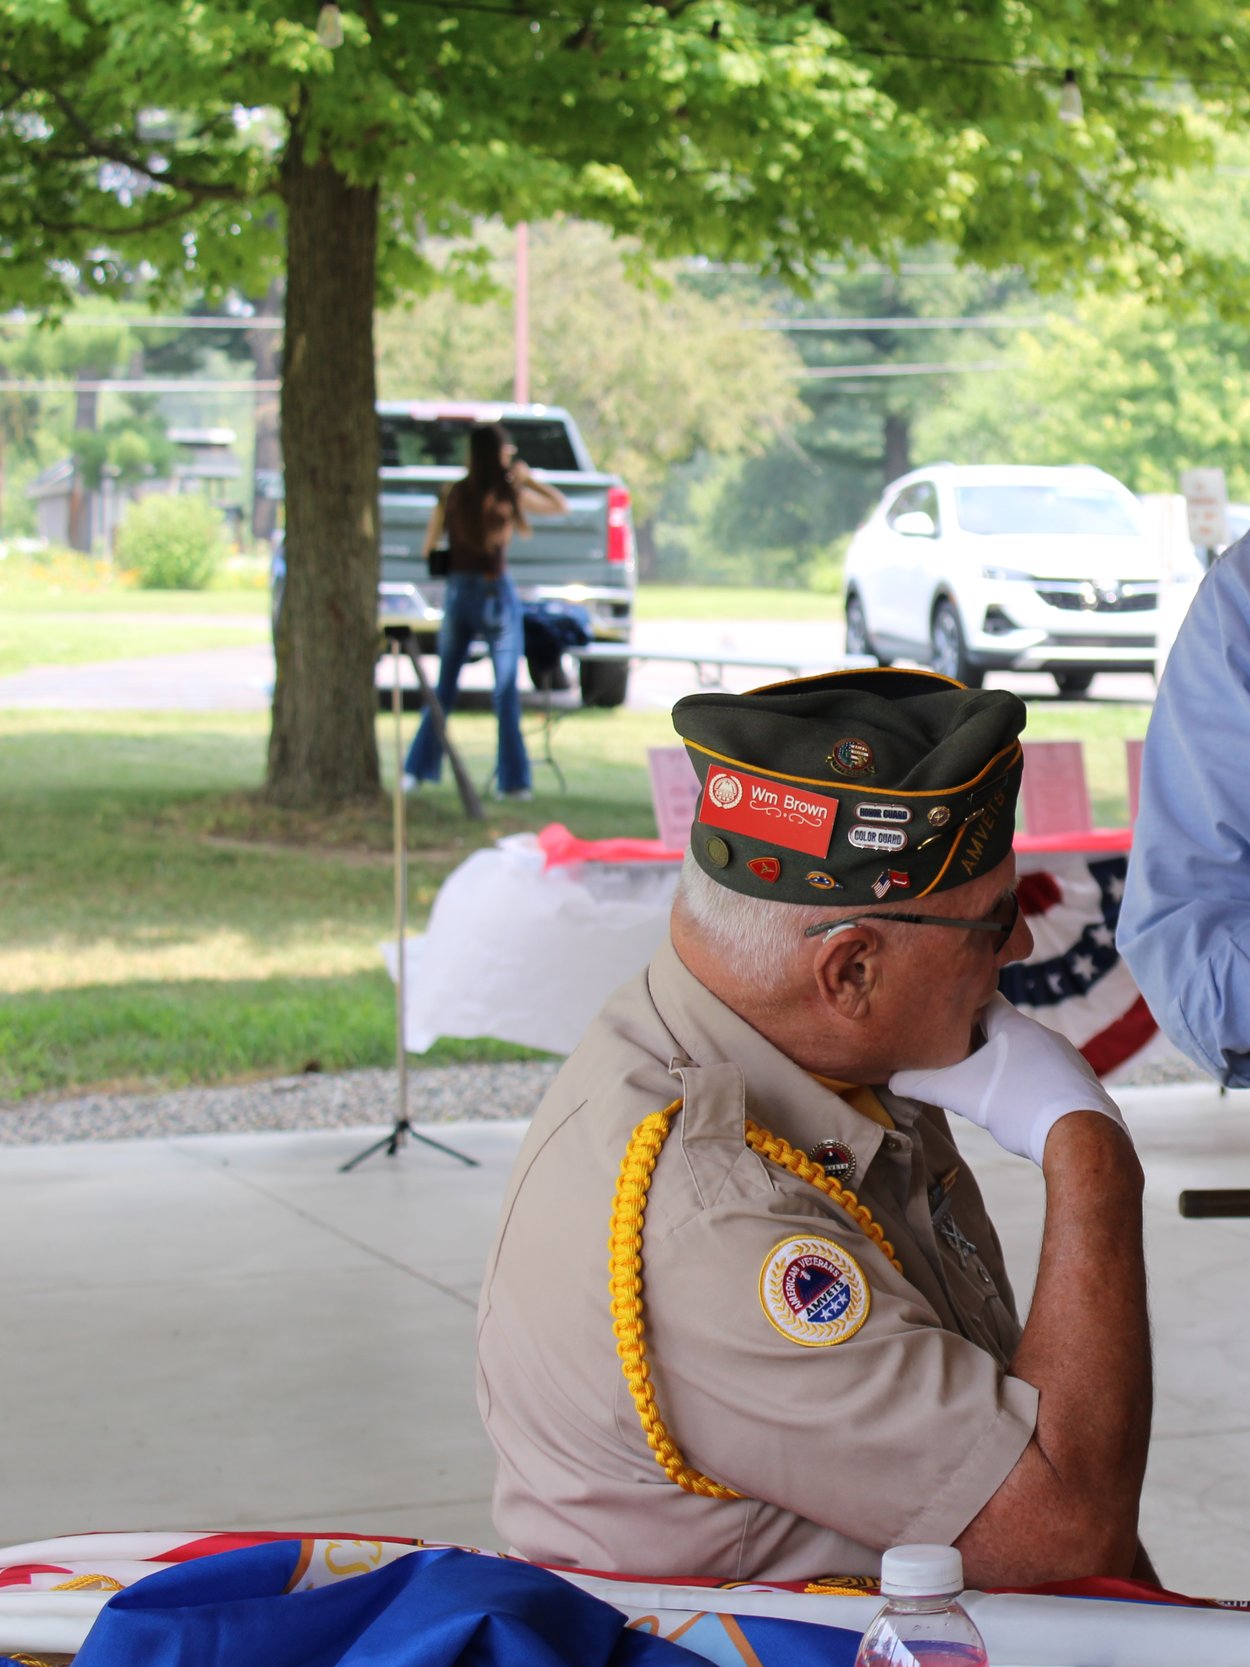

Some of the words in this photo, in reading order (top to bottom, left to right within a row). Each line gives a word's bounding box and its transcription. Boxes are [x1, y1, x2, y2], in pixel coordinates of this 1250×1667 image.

[751, 785, 778, 805] Wm
[784, 795, 828, 819] Brown
[860, 807, 882, 818] HONOR
[883, 809, 908, 820] GUARD
[854, 830, 877, 842] COLOR
[878, 832, 902, 845] GUARD
[786, 1265, 803, 1309] AMERICAN
[800, 1257, 840, 1277] VETERANS
[805, 1281, 844, 1317] AMVETS
